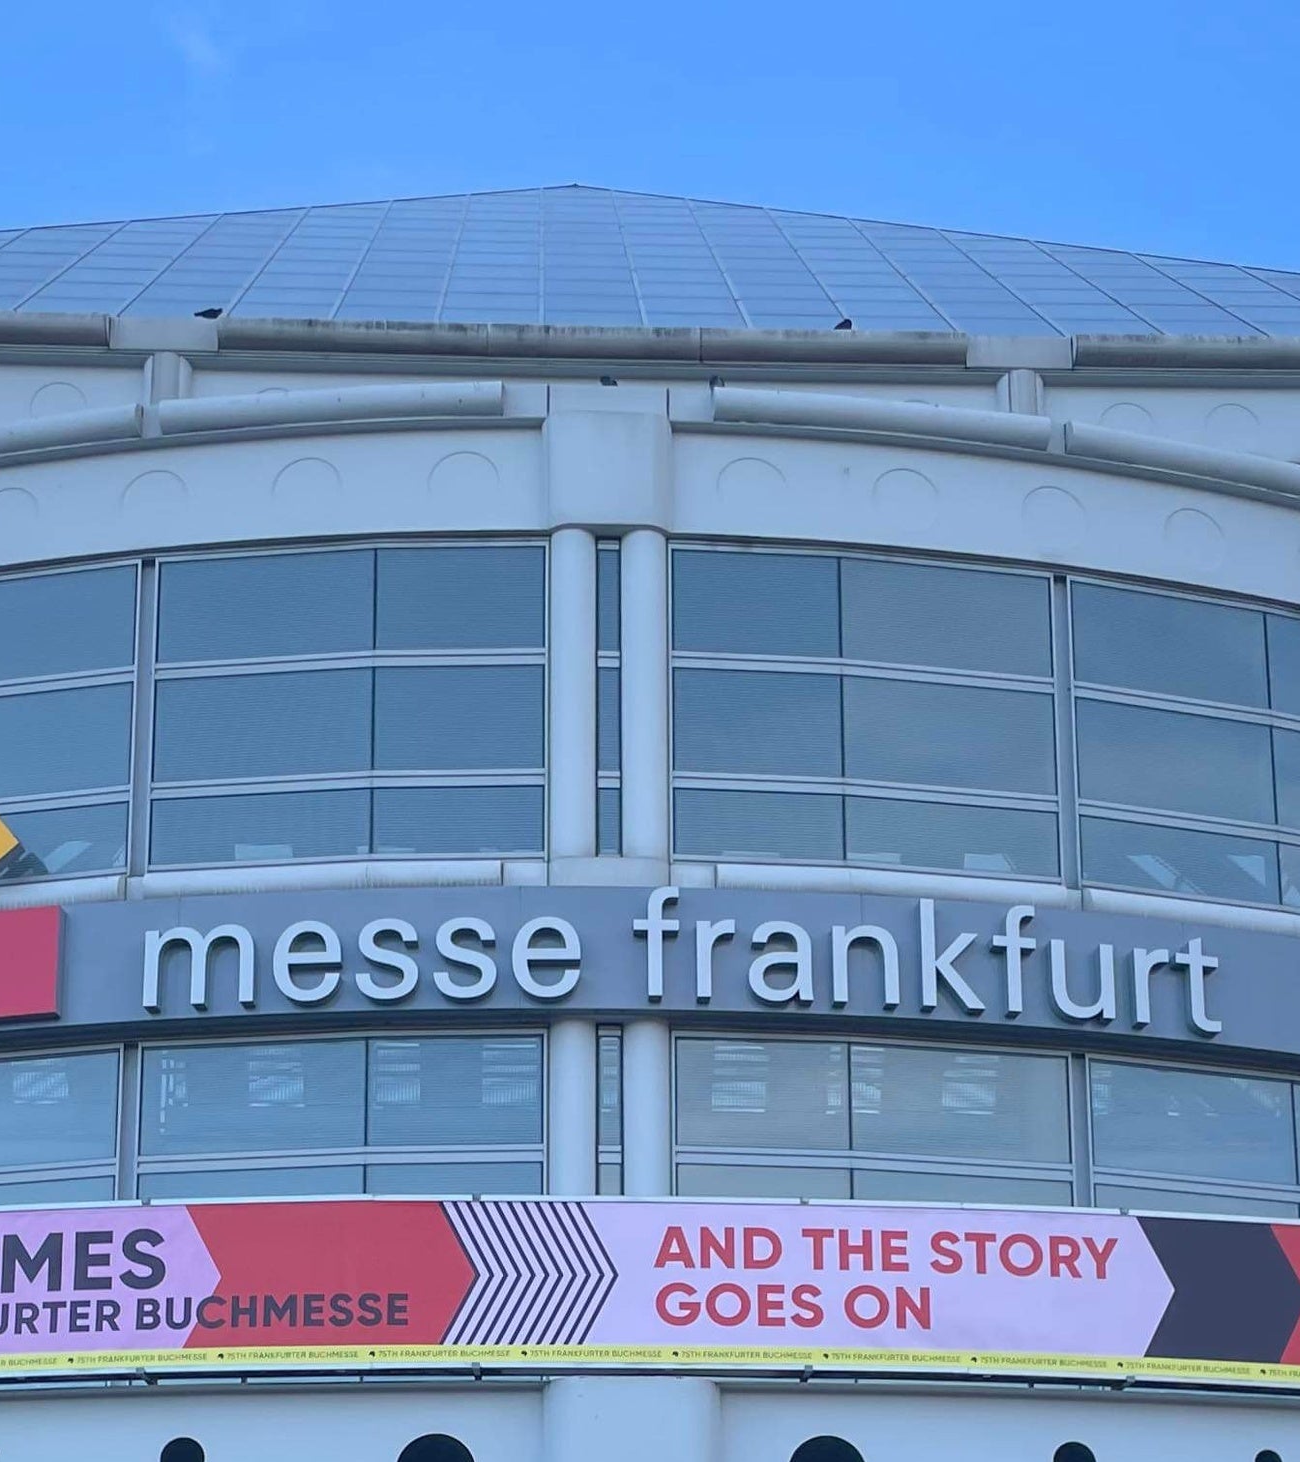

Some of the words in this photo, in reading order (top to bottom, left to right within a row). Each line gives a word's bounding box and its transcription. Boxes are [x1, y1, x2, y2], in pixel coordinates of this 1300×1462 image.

[142, 916, 581, 1013] messe
[633, 886, 1223, 1036] frankfurt
[654, 1226, 783, 1269] AND
[801, 1228, 908, 1271] THE
[929, 1231, 1119, 1280] STORY
[655, 1283, 824, 1329] GOES
[844, 1284, 931, 1330] ON
[135, 1293, 409, 1330] BUCHMESSE
[98, 1355, 155, 1363] FRANKFURTER
[158, 1353, 207, 1361] BUCHMESSE
[248, 1351, 306, 1359] FRANKFURTER
[309, 1351, 358, 1359] BUCHMESSE
[400, 1350, 458, 1358] FRANKFURTER
[612, 1350, 662, 1358] BUCHMESSE
[763, 1352, 812, 1360] BUCHMESSE
[912, 1355, 960, 1363] BUCHMESSE
